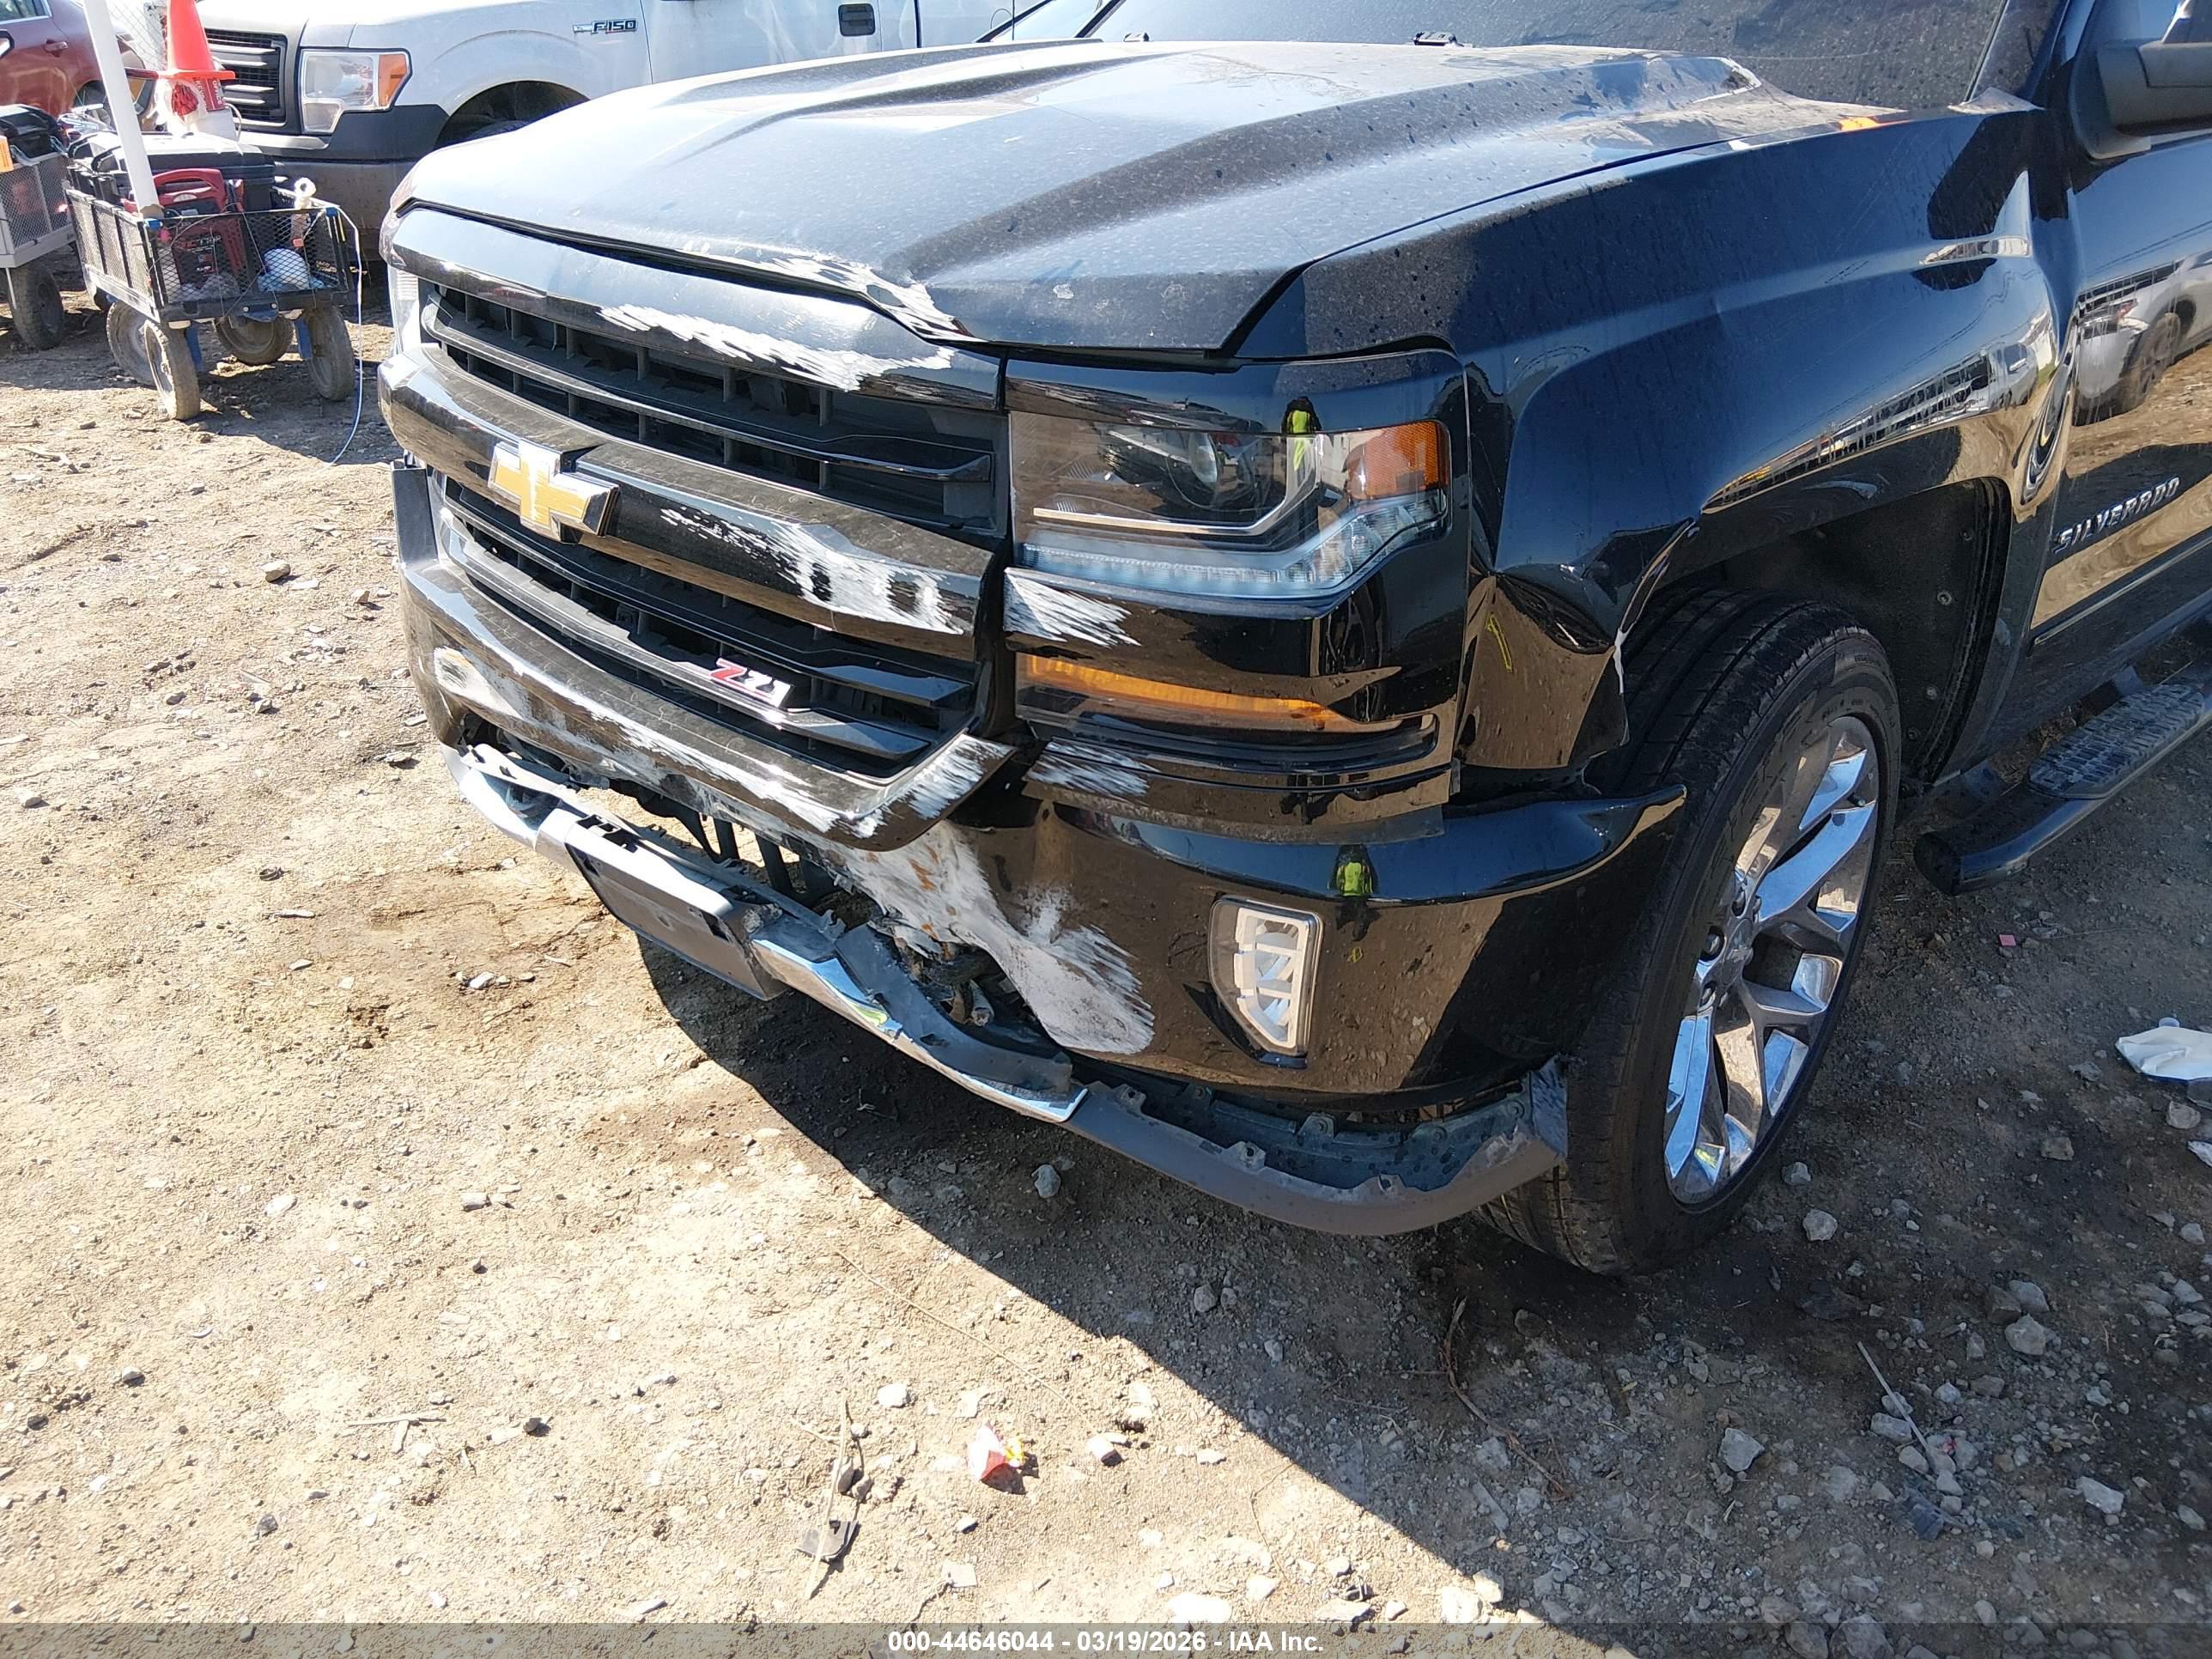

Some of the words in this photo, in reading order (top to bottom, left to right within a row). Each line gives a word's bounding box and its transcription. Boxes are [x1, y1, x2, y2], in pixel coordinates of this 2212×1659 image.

[592, 20, 636, 33] F-150
[2053, 477, 2180, 554] SILVERADO
[710, 658, 791, 708] Z71
